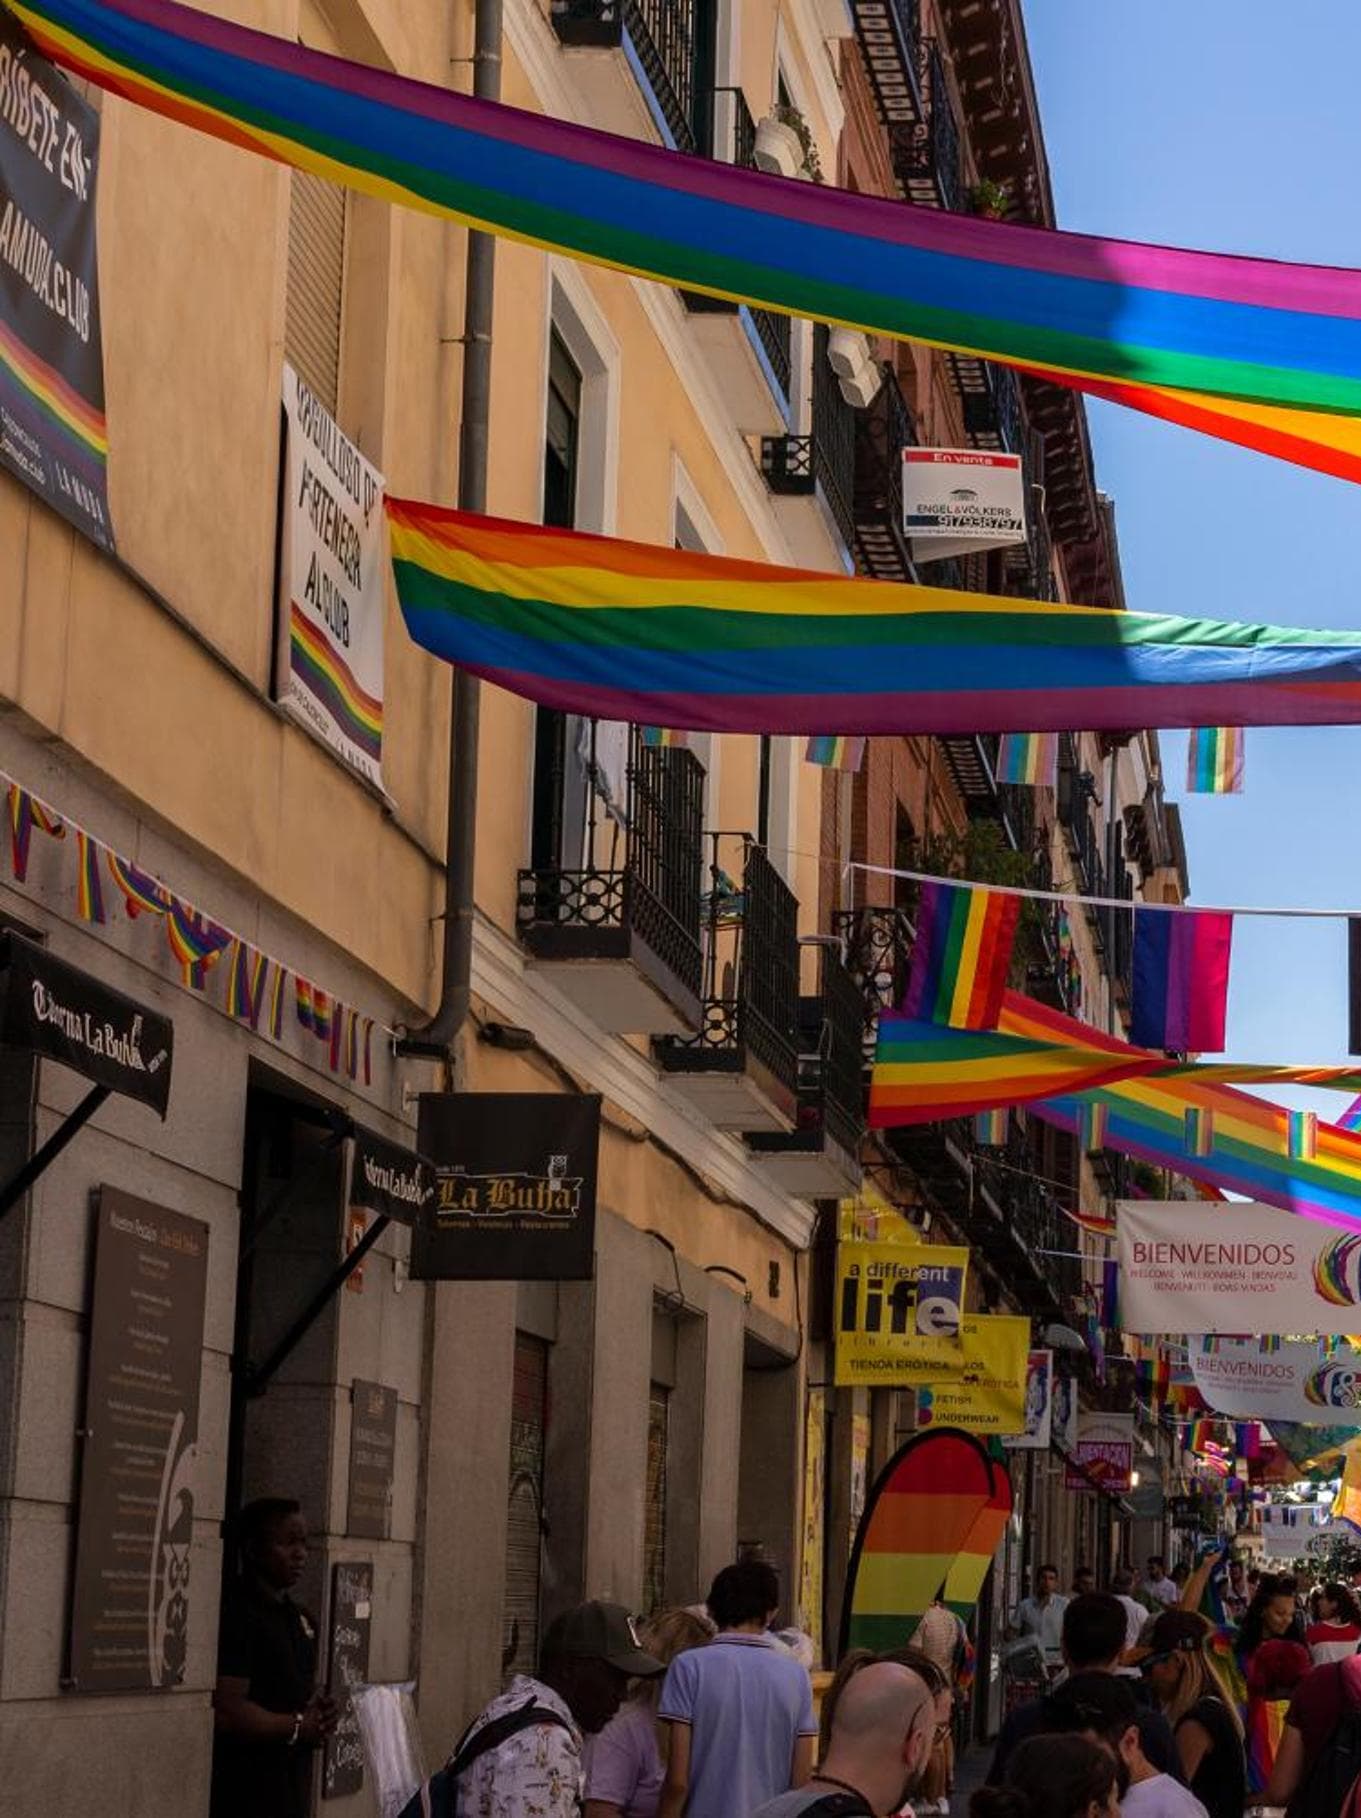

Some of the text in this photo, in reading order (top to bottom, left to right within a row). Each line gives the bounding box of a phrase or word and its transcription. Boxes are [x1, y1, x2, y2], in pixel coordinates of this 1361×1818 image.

[437, 1178, 478, 1209] La
[1132, 1242, 1296, 1266] BIENVENIDOS
[849, 1262, 950, 1283] a different
[841, 1277, 960, 1337] life
[1196, 1357, 1295, 1380] BIENVENIDOS
